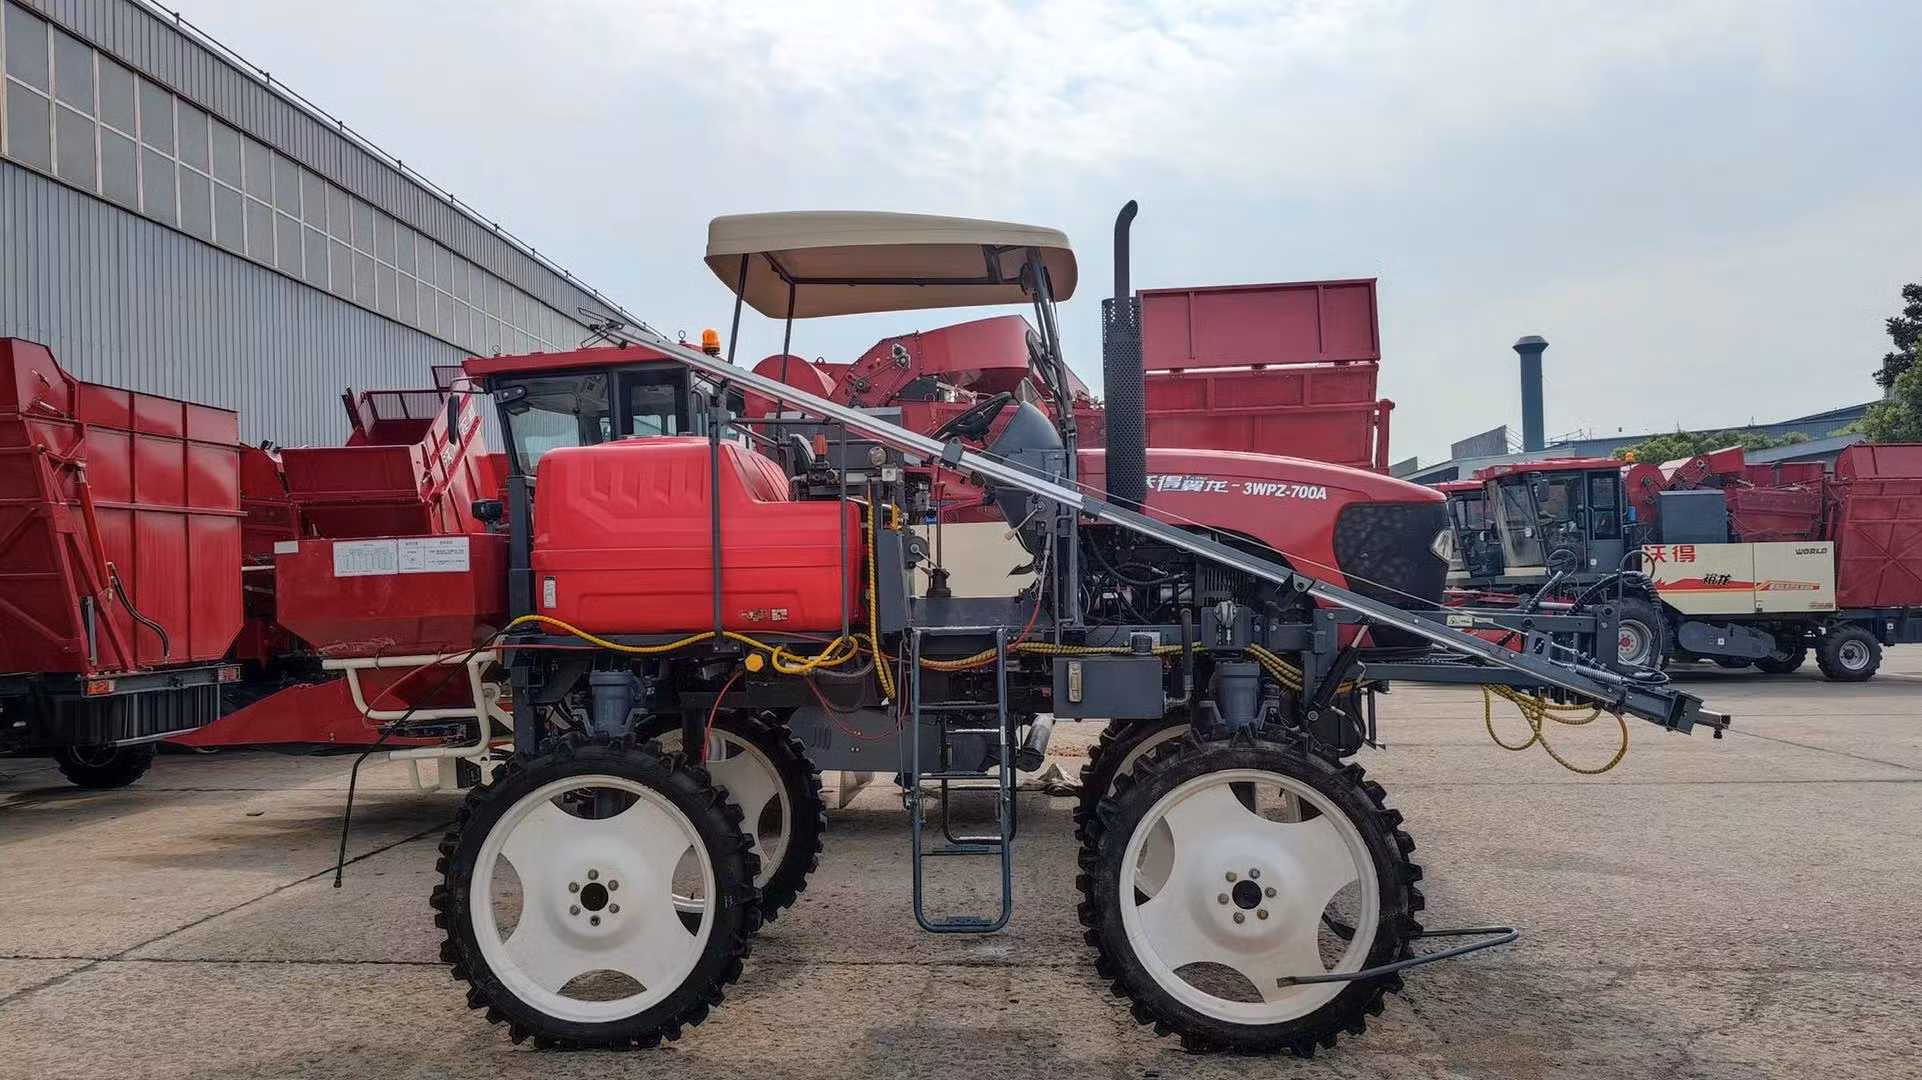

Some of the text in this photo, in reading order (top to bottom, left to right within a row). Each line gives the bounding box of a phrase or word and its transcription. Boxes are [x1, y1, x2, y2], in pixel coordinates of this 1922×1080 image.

[1243, 481, 1327, 500] 3WPZ-700A
[1643, 545, 1696, 563] 沃得
[1795, 547, 1828, 555] WORLD
